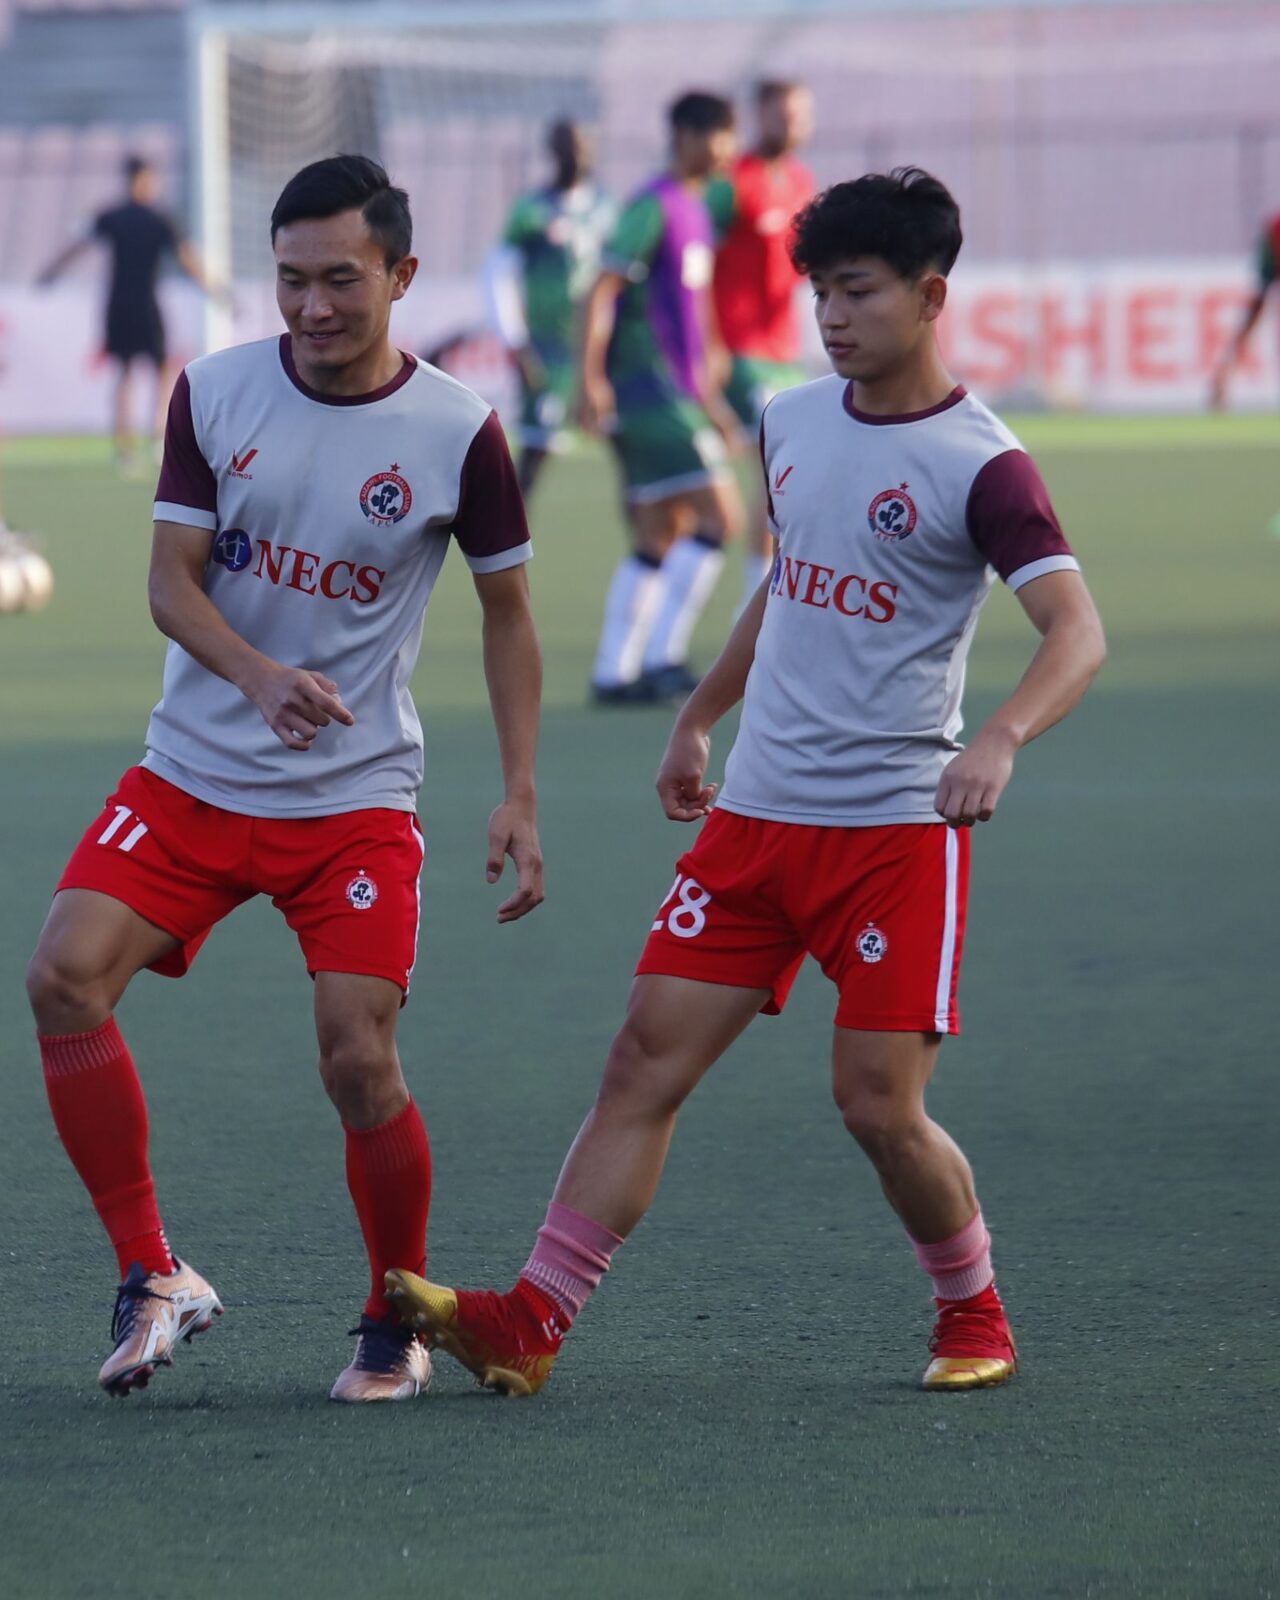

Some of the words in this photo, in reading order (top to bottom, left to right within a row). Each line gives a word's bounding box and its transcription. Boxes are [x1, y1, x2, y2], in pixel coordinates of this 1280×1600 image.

[252, 539, 386, 604] NECS
[777, 556, 898, 624] NECS
[97, 805, 149, 852] 11
